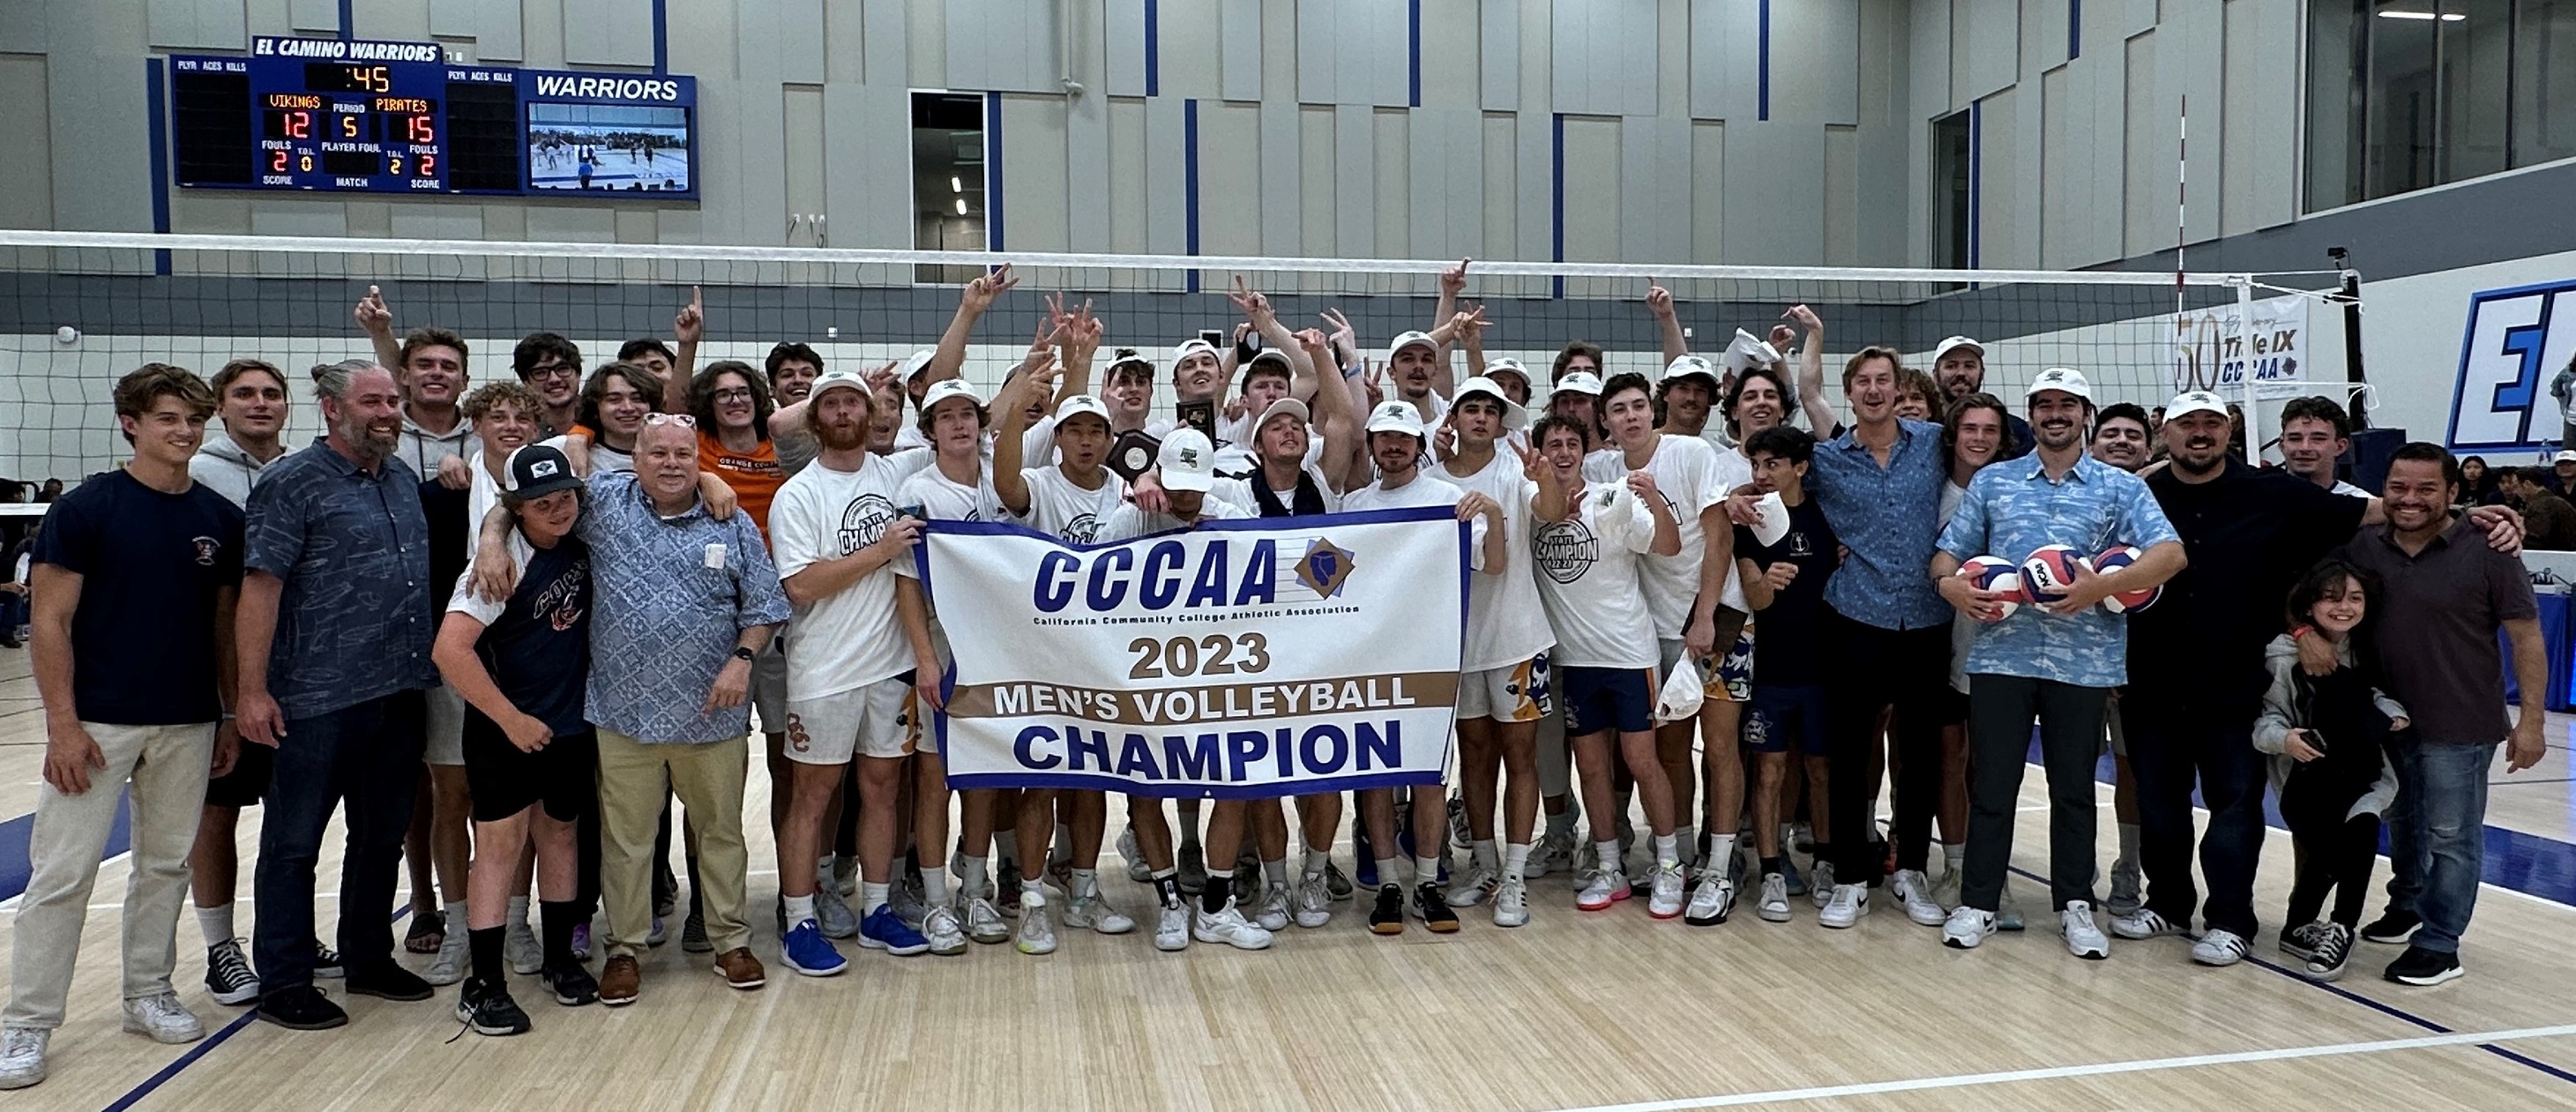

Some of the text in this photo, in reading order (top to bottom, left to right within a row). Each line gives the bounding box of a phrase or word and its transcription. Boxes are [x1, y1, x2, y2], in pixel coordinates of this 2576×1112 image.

[256, 39, 274, 56] EL
[278, 40, 346, 57] CAMINO
[350, 42, 437, 62] WARRIORS
[536, 75, 678, 101] WARRIORS
[270, 94, 320, 108] VIKINGS
[333, 103, 365, 113] PERIOD
[376, 98, 427, 113] PIRATES
[284, 112, 309, 138] 12
[343, 116, 357, 137] 5
[408, 116, 433, 143] 15
[261, 140, 292, 150] FOULS
[321, 141, 381, 153] PLAYER FOUL
[409, 144, 438, 154] FOULS
[273, 151, 287, 171] 2
[301, 155, 312, 172] 0
[390, 159, 401, 175] 2
[421, 155, 434, 175] 2
[263, 175, 293, 185] SCORE
[336, 177, 369, 187] MATCH
[411, 179, 440, 189] SCORE
[2224, 329, 2297, 359] Tile IX
[2222, 357, 2278, 384] CCAA
[1034, 539, 1276, 614] CCCAA
[1102, 616, 1173, 624] Community
[1178, 614, 1226, 623] College
[1231, 610, 1281, 620] Athletic
[1286, 606, 1360, 616] Association
[1128, 632, 1270, 680] 2023
[993, 677, 1415, 722] MEN'S VOLLEYBALL
[1012, 720, 1401, 781] CHAMPION
